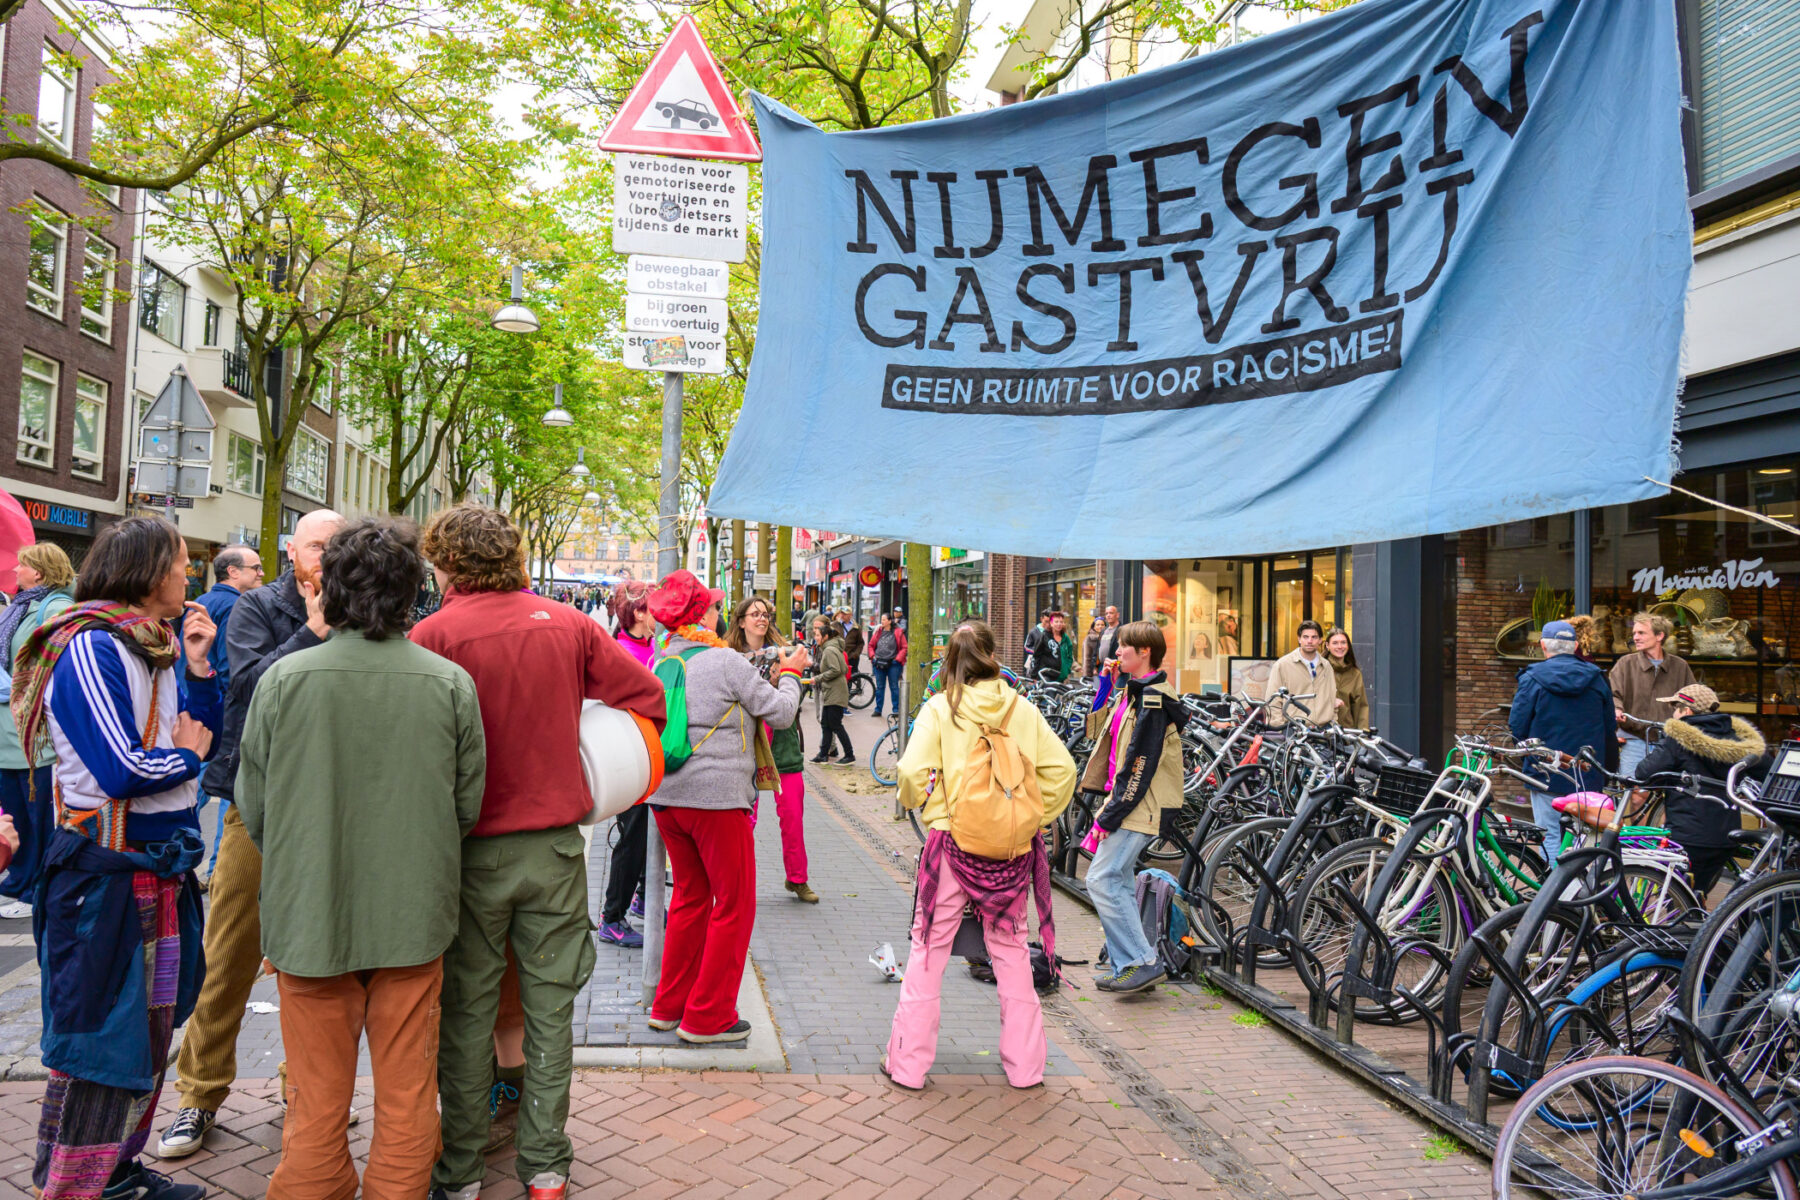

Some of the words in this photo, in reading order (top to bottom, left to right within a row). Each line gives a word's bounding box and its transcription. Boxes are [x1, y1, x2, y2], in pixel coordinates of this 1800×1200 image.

[845, 10, 1543, 258] NIJMEGEN
[629, 160, 695, 175] verboden
[701, 167, 732, 179] voor
[623, 174, 736, 194] gemotoriseerde
[629, 190, 707, 207] voertuigen
[713, 198, 730, 208] en
[618, 217, 669, 232] tijdens
[673, 222, 690, 233] de
[696, 226, 739, 238] markt
[634, 260, 720, 278] beweegbaar
[854, 169, 1474, 353] GASTVRIJ
[647, 278, 707, 293] obstakel
[647, 298, 664, 314] bij
[666, 302, 707, 314] groen
[633, 316, 659, 327] een
[662, 319, 720, 333] voertuig
[688, 340, 721, 350] voor
[891, 375, 974, 405] GEEN
[982, 375, 1101, 405] RUIMTE
[1109, 366, 1201, 401] VOOR
[1213, 323, 1396, 389] RACISME!
[24, 500, 49, 521] YOU
[49, 505, 88, 528] MOBILE
[1133, 755, 1147, 781] URBAN
[1126, 780, 1140, 801] WEAR
[1478, 842, 1508, 886] VOGUE
